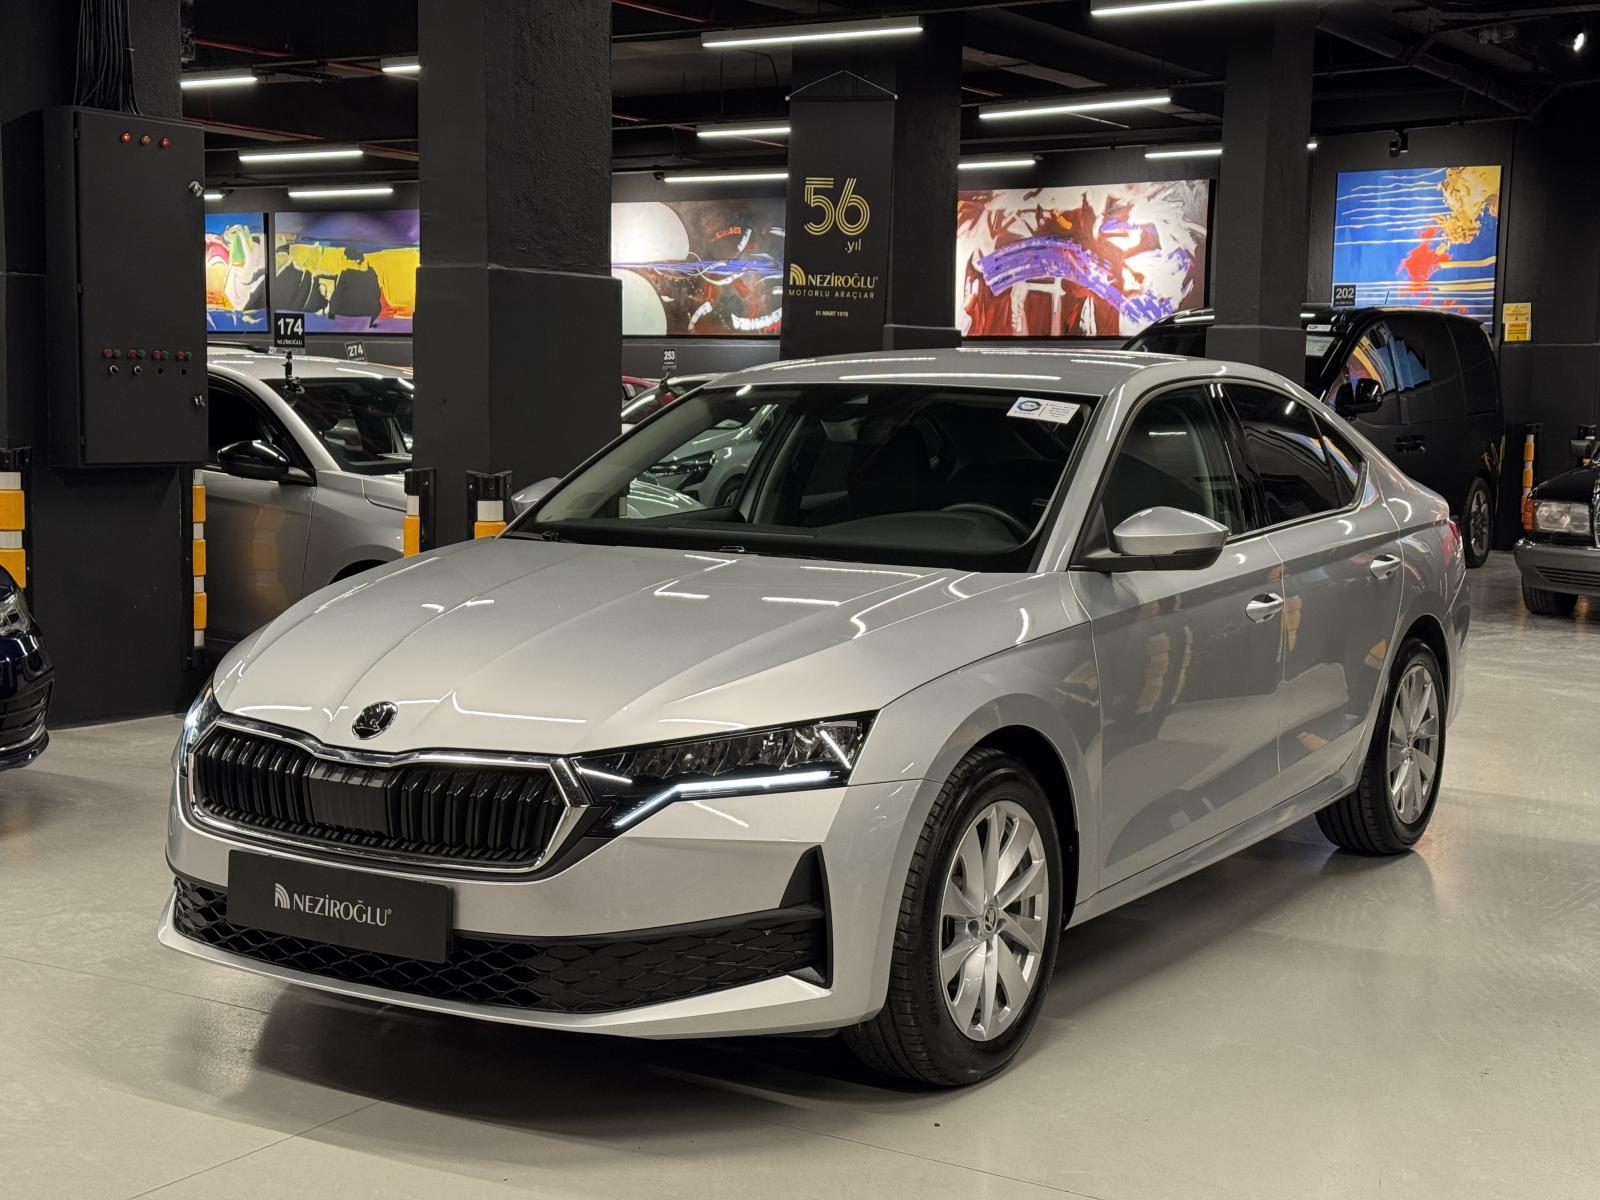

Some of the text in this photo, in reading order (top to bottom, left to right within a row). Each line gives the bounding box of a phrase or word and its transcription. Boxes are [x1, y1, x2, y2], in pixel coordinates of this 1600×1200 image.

[804, 176, 870, 236] 56
[788, 289, 875, 299] MOTORLU ARAÇLAR
[1335, 288, 1354, 299] 202
[278, 318, 303, 335] 174
[348, 344, 364, 357] 274
